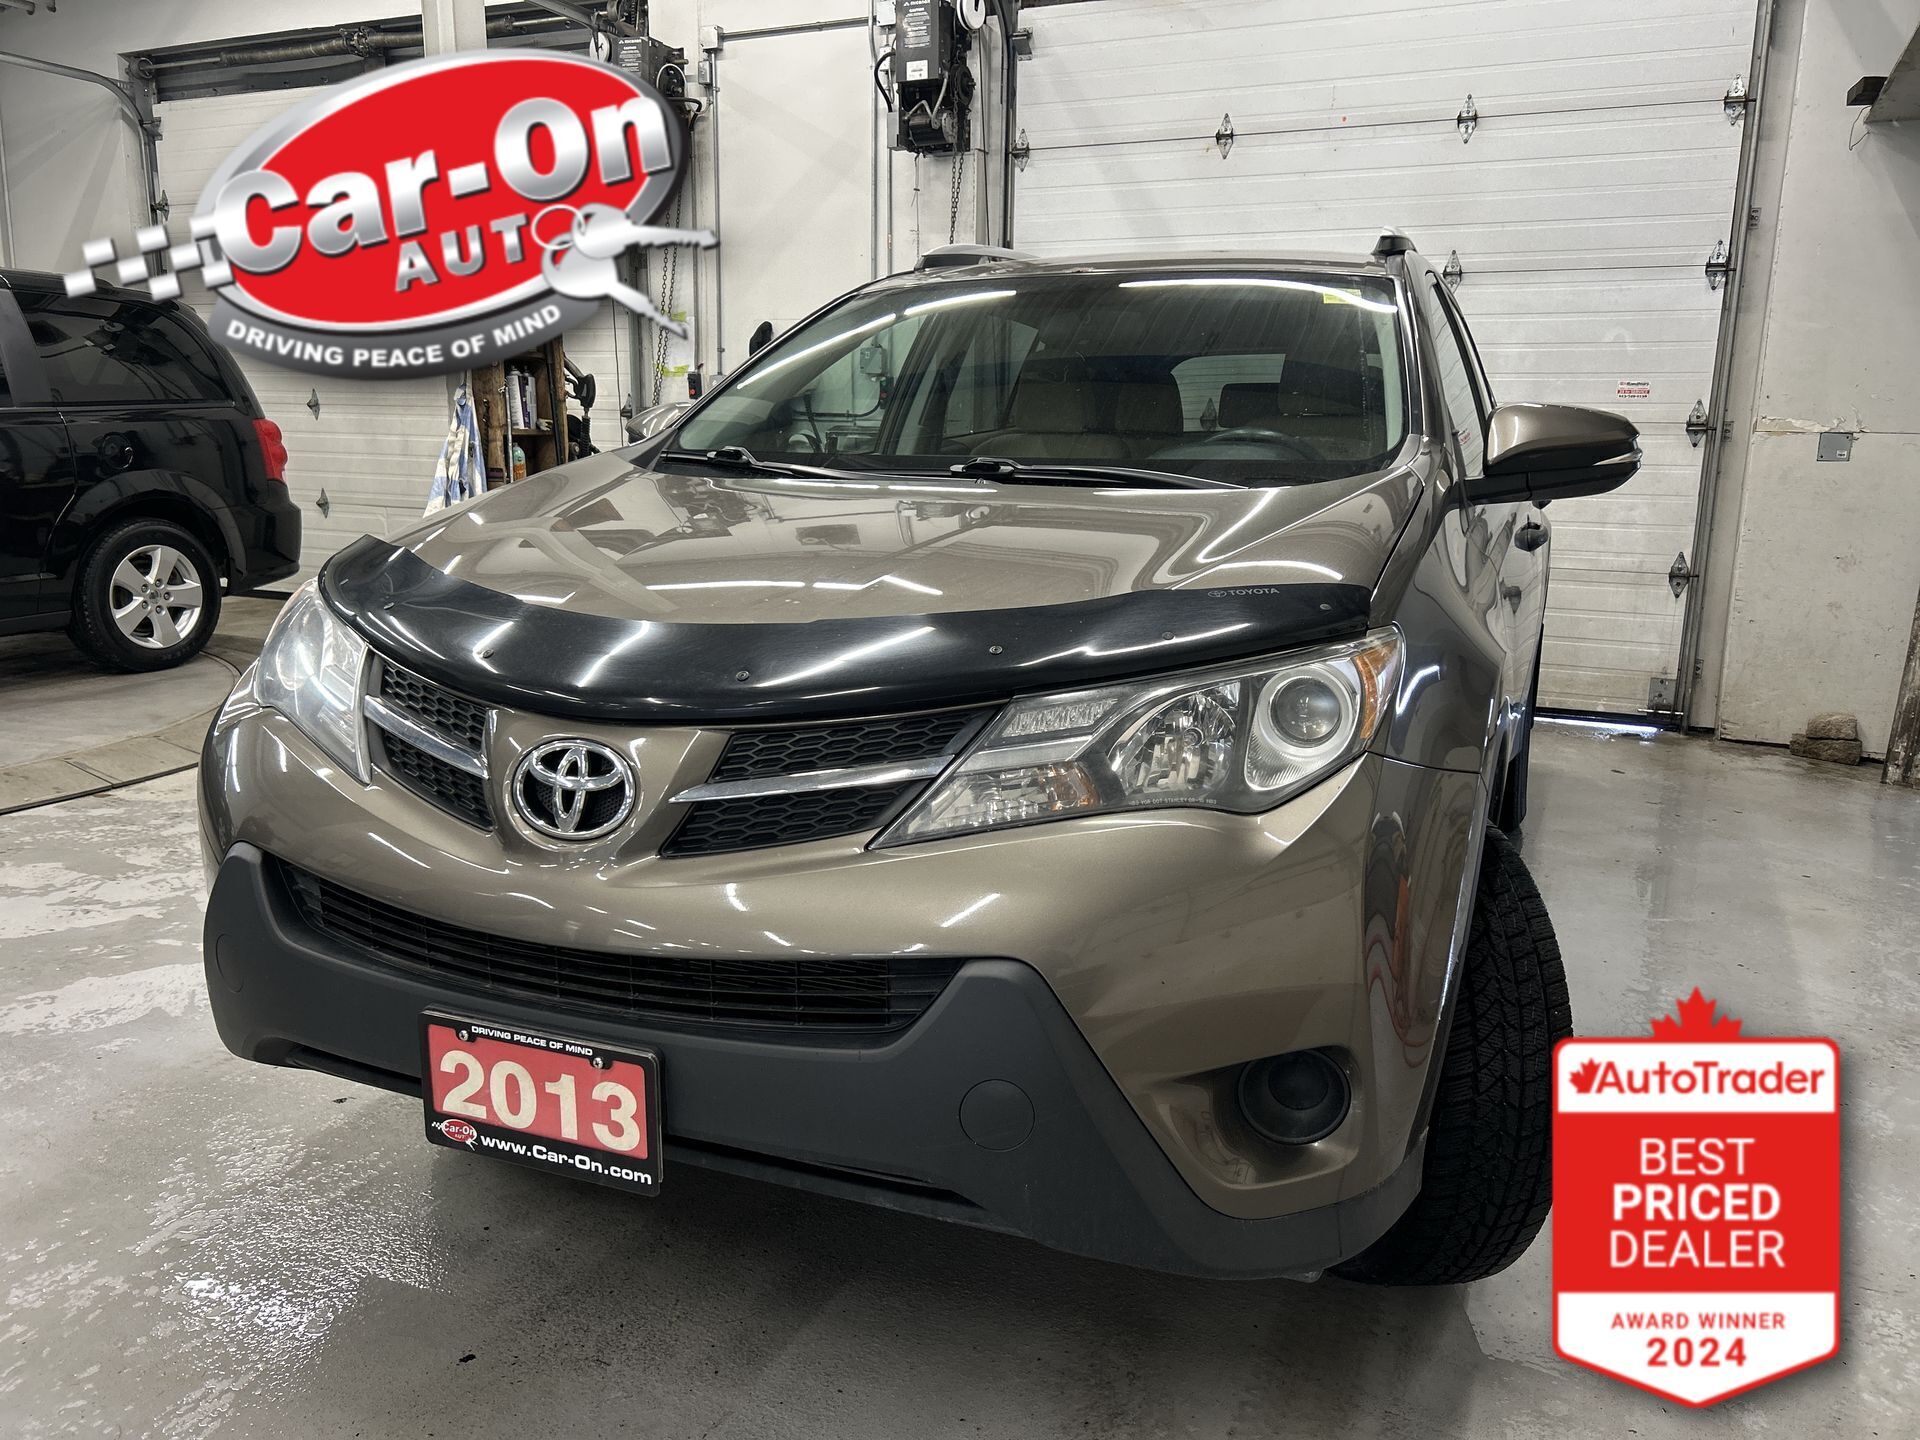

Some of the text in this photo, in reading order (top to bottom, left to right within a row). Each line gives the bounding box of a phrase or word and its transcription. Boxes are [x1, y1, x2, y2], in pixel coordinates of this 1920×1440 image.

[1227, 587, 1280, 596] TOYOTA
[471, 1025, 593, 1056] DRIVING PEACE OF MIND
[440, 1049, 641, 1151] 2013
[442, 1122, 476, 1136] Car-On
[480, 1135, 652, 1185] www.Car-On.com
